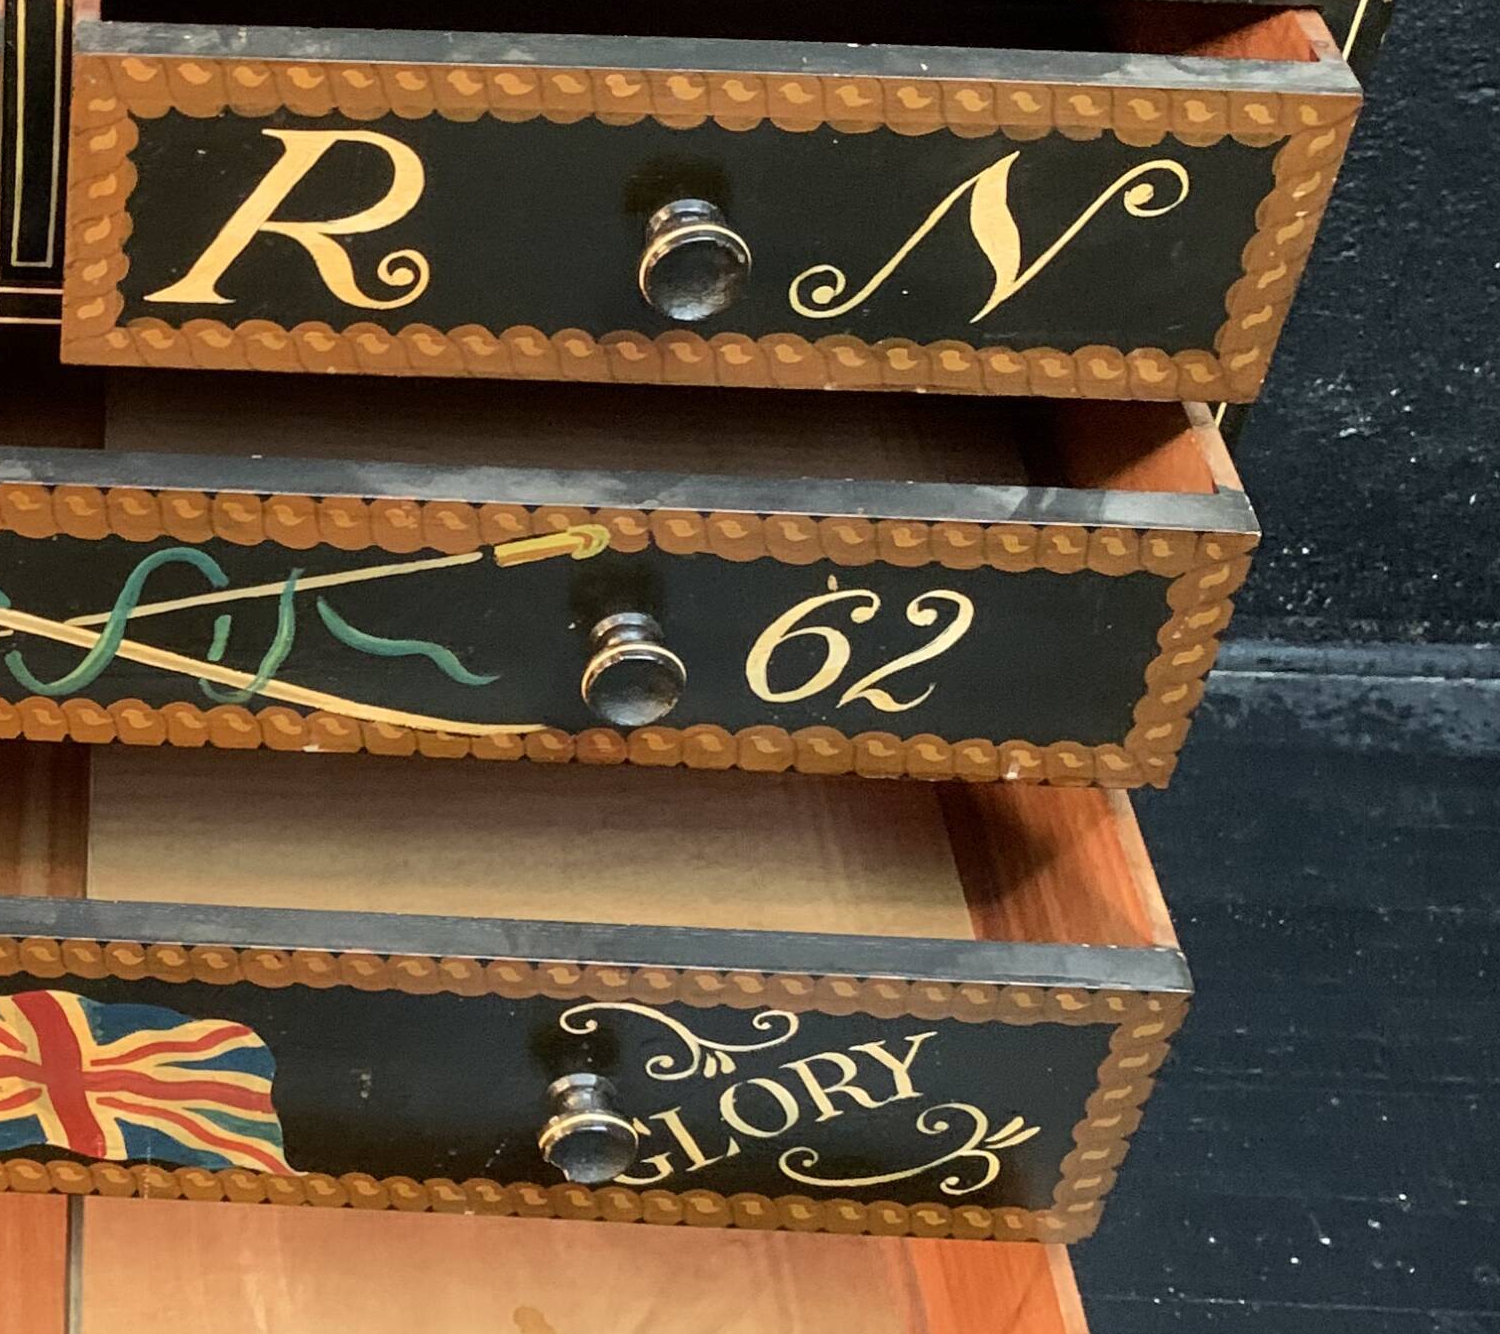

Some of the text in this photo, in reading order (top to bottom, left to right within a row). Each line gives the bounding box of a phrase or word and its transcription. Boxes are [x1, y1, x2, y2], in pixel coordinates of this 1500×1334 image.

[143, 128, 1190, 324] R N
[745, 588, 976, 714] 62
